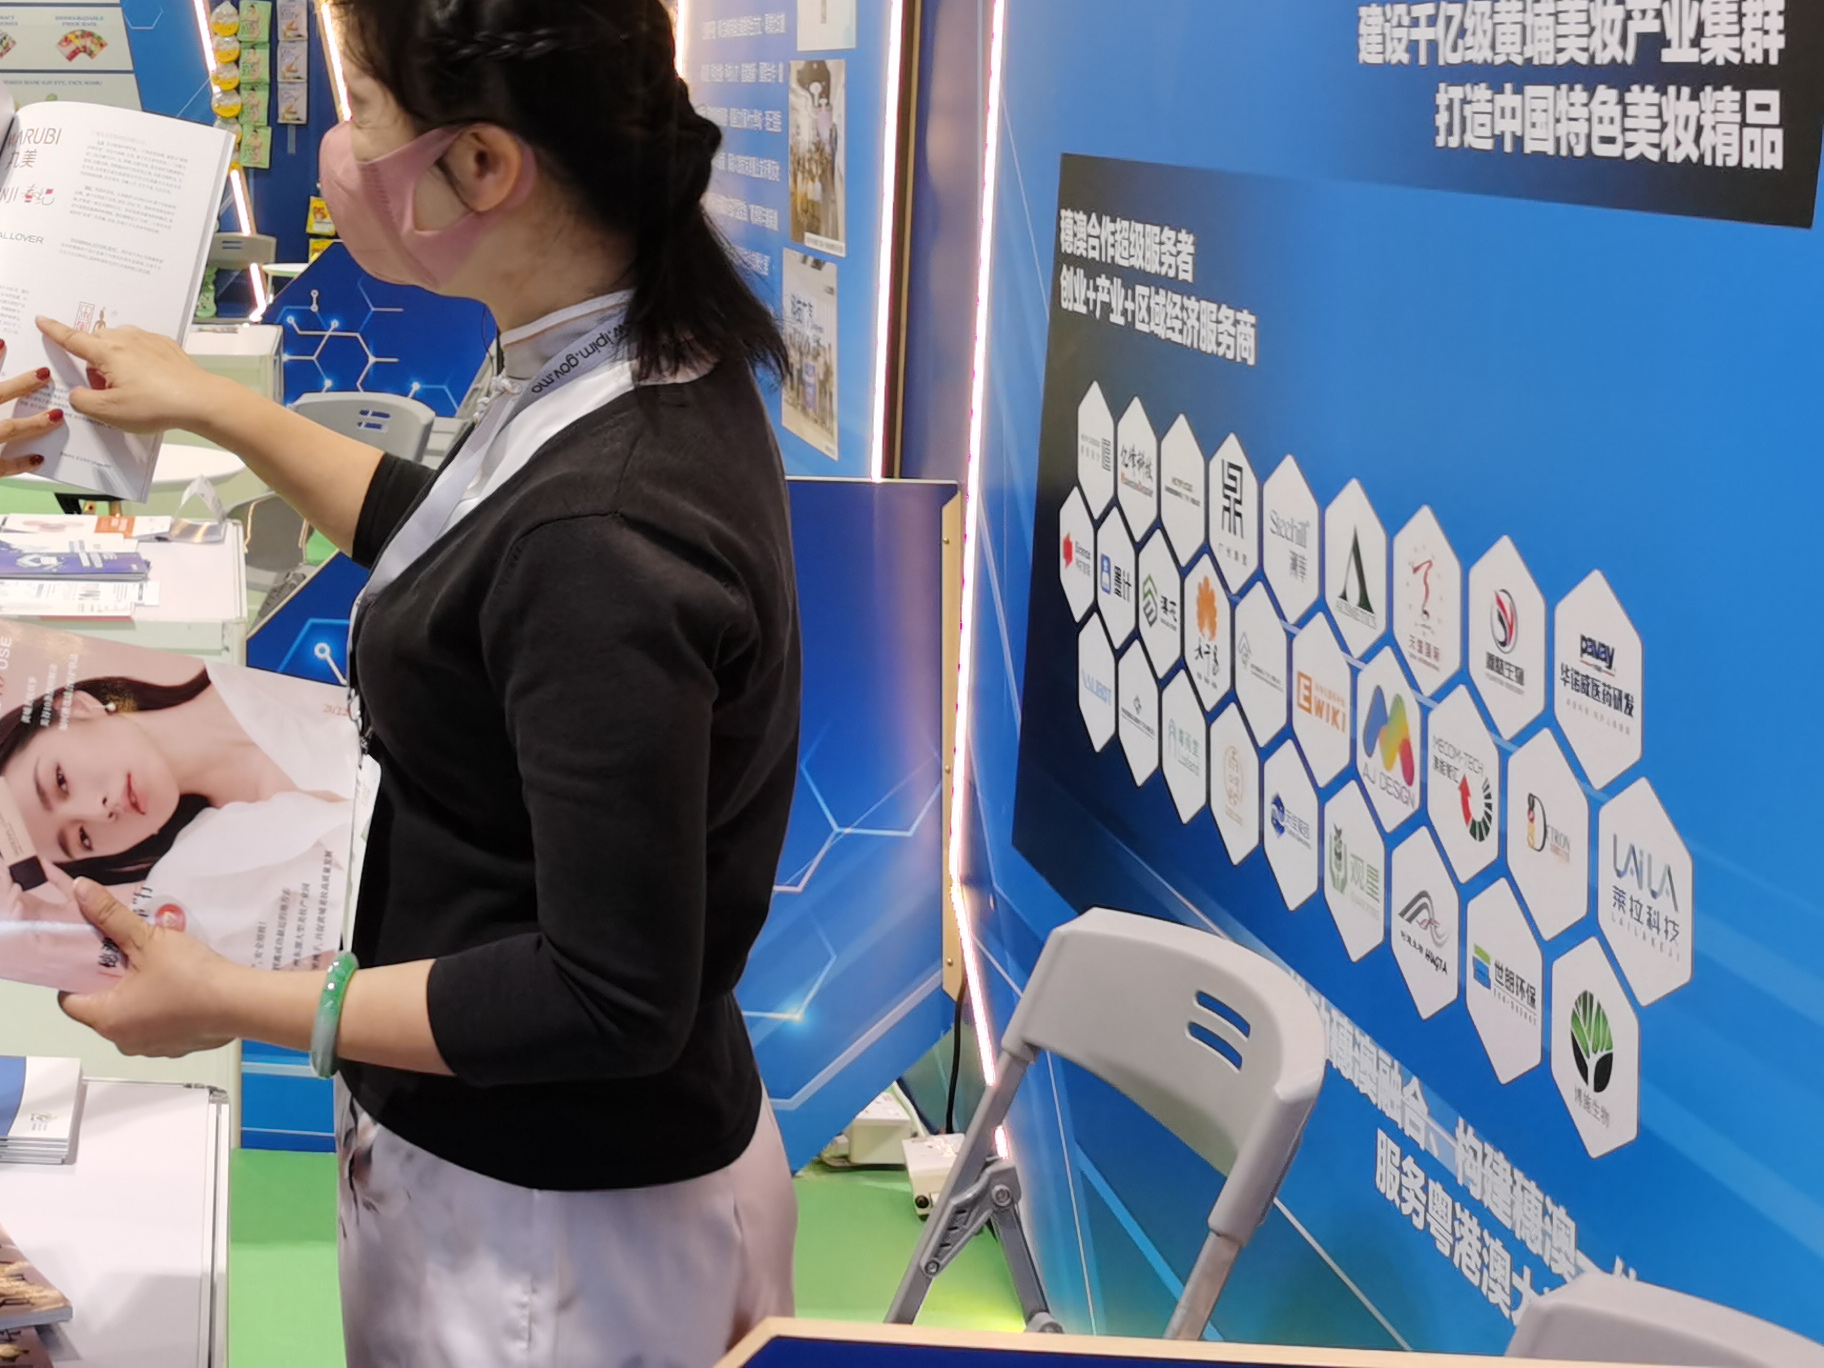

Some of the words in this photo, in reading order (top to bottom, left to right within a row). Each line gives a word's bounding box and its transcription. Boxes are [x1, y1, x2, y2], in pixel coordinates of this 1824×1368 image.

[1434, 84, 1786, 171] 打造中国特色美妆精品
[1059, 208, 1196, 284] 穗澳合作超级服务者
[1379, 777, 1416, 809] DESIGN
[1376, 1127, 1538, 1327] 服务粤港澳大
